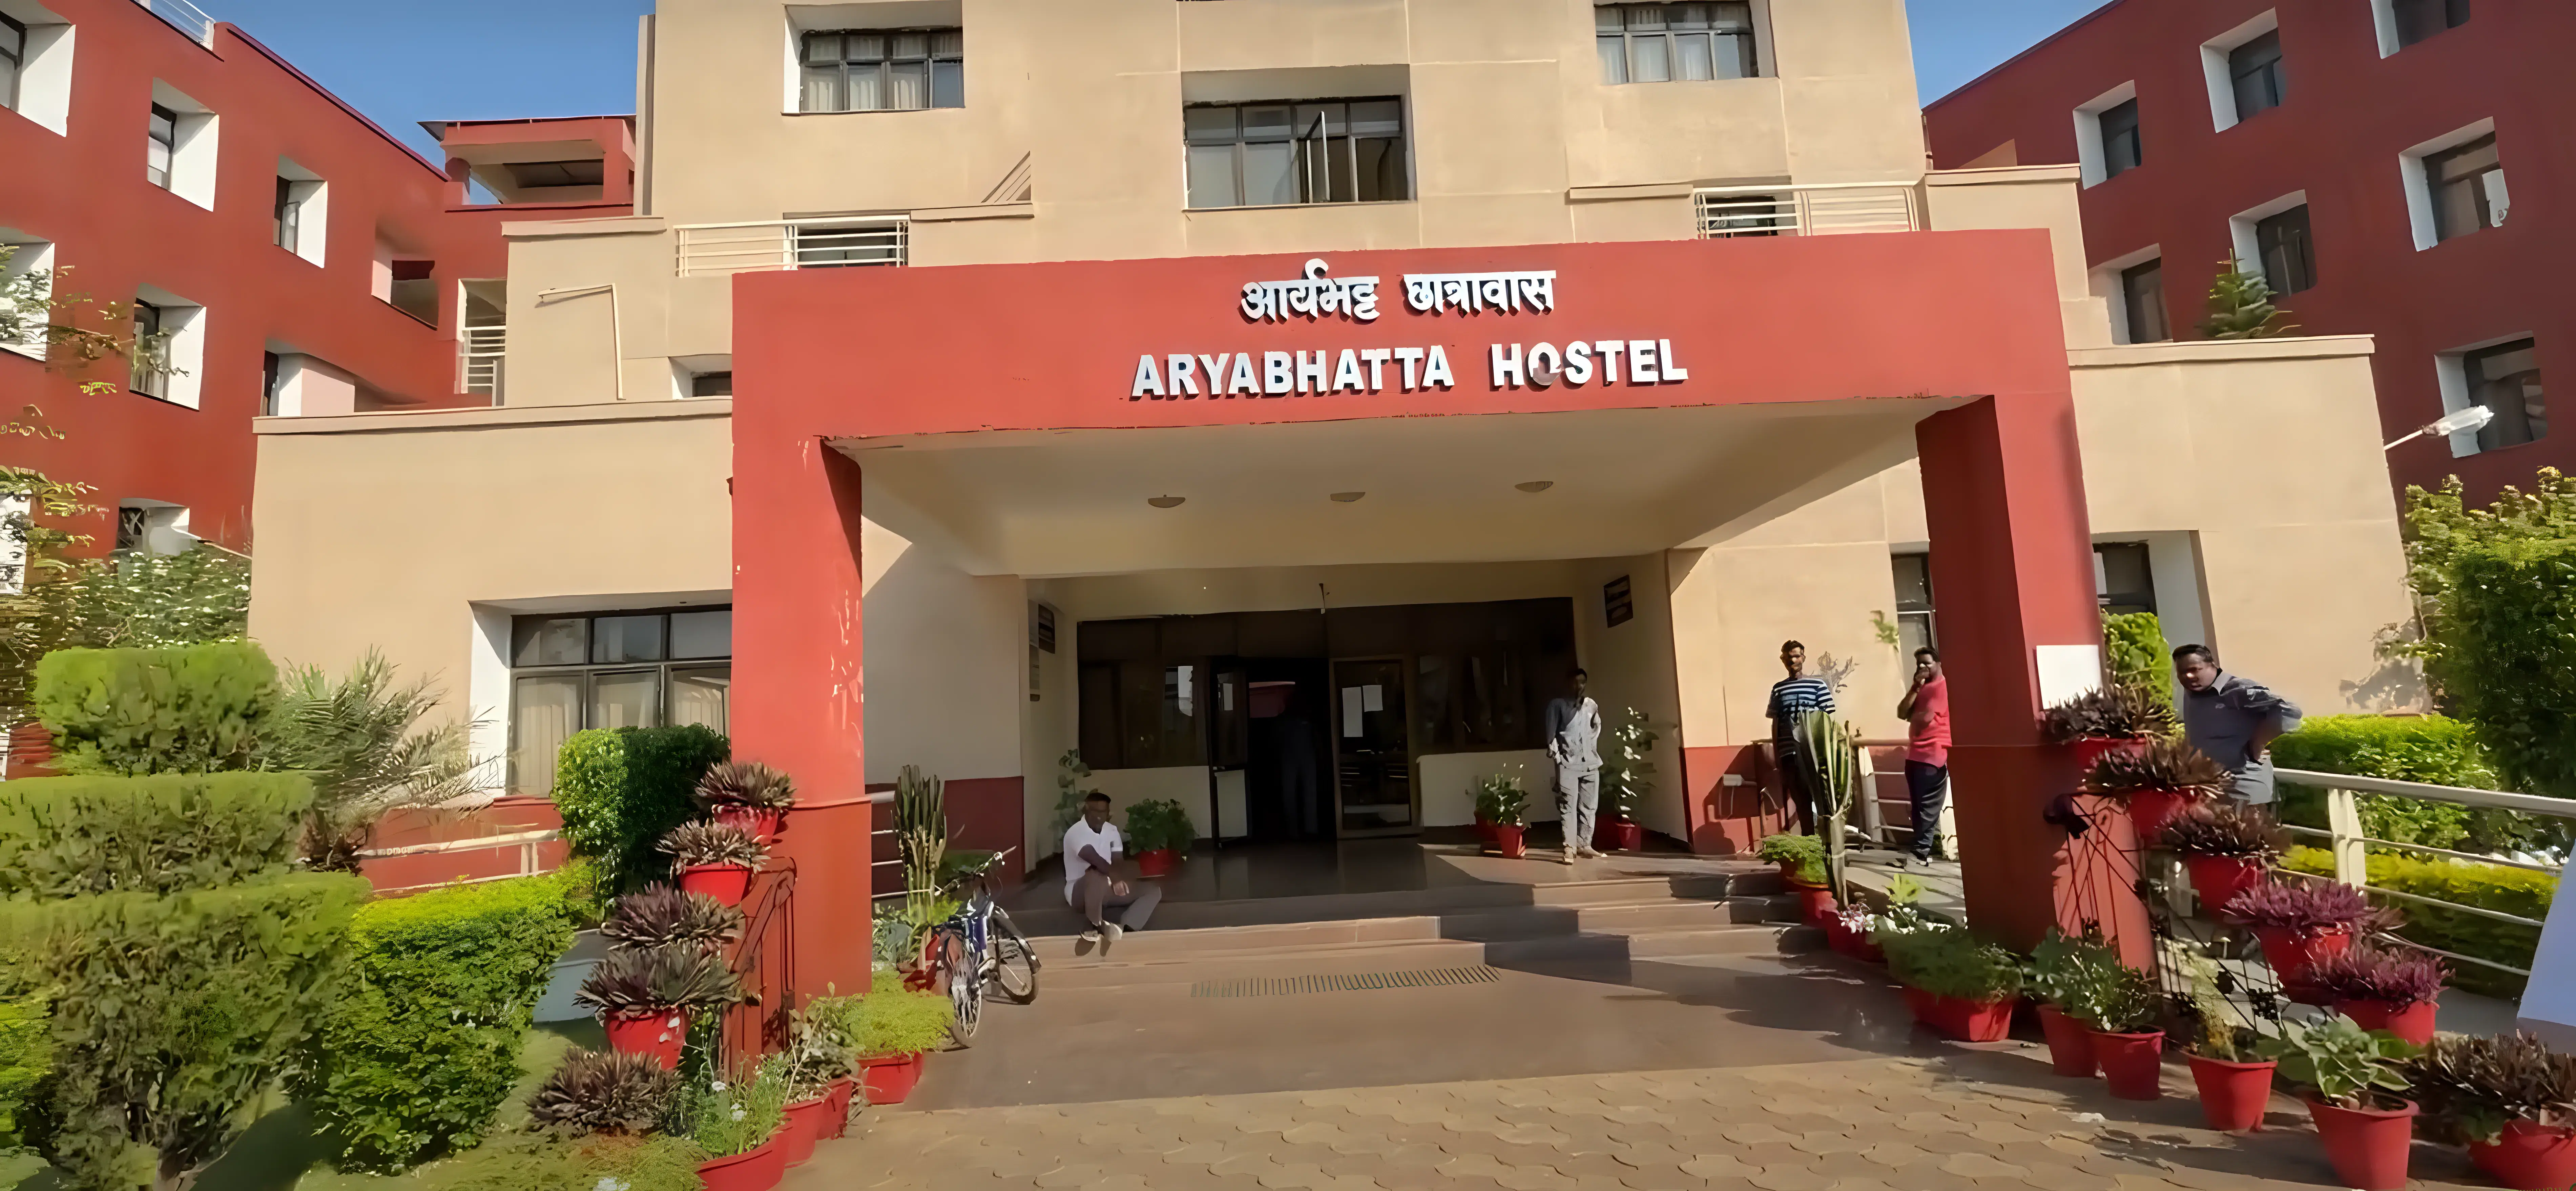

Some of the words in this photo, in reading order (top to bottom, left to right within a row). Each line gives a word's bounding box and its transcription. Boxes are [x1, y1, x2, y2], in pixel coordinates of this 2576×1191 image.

[1241, 258, 1380, 321] आर्यभट्ट
[1402, 270, 1557, 315] छात्रावास
[1131, 344, 1455, 397] ARYABHATTA
[1491, 338, 1689, 386] HOSTEL
